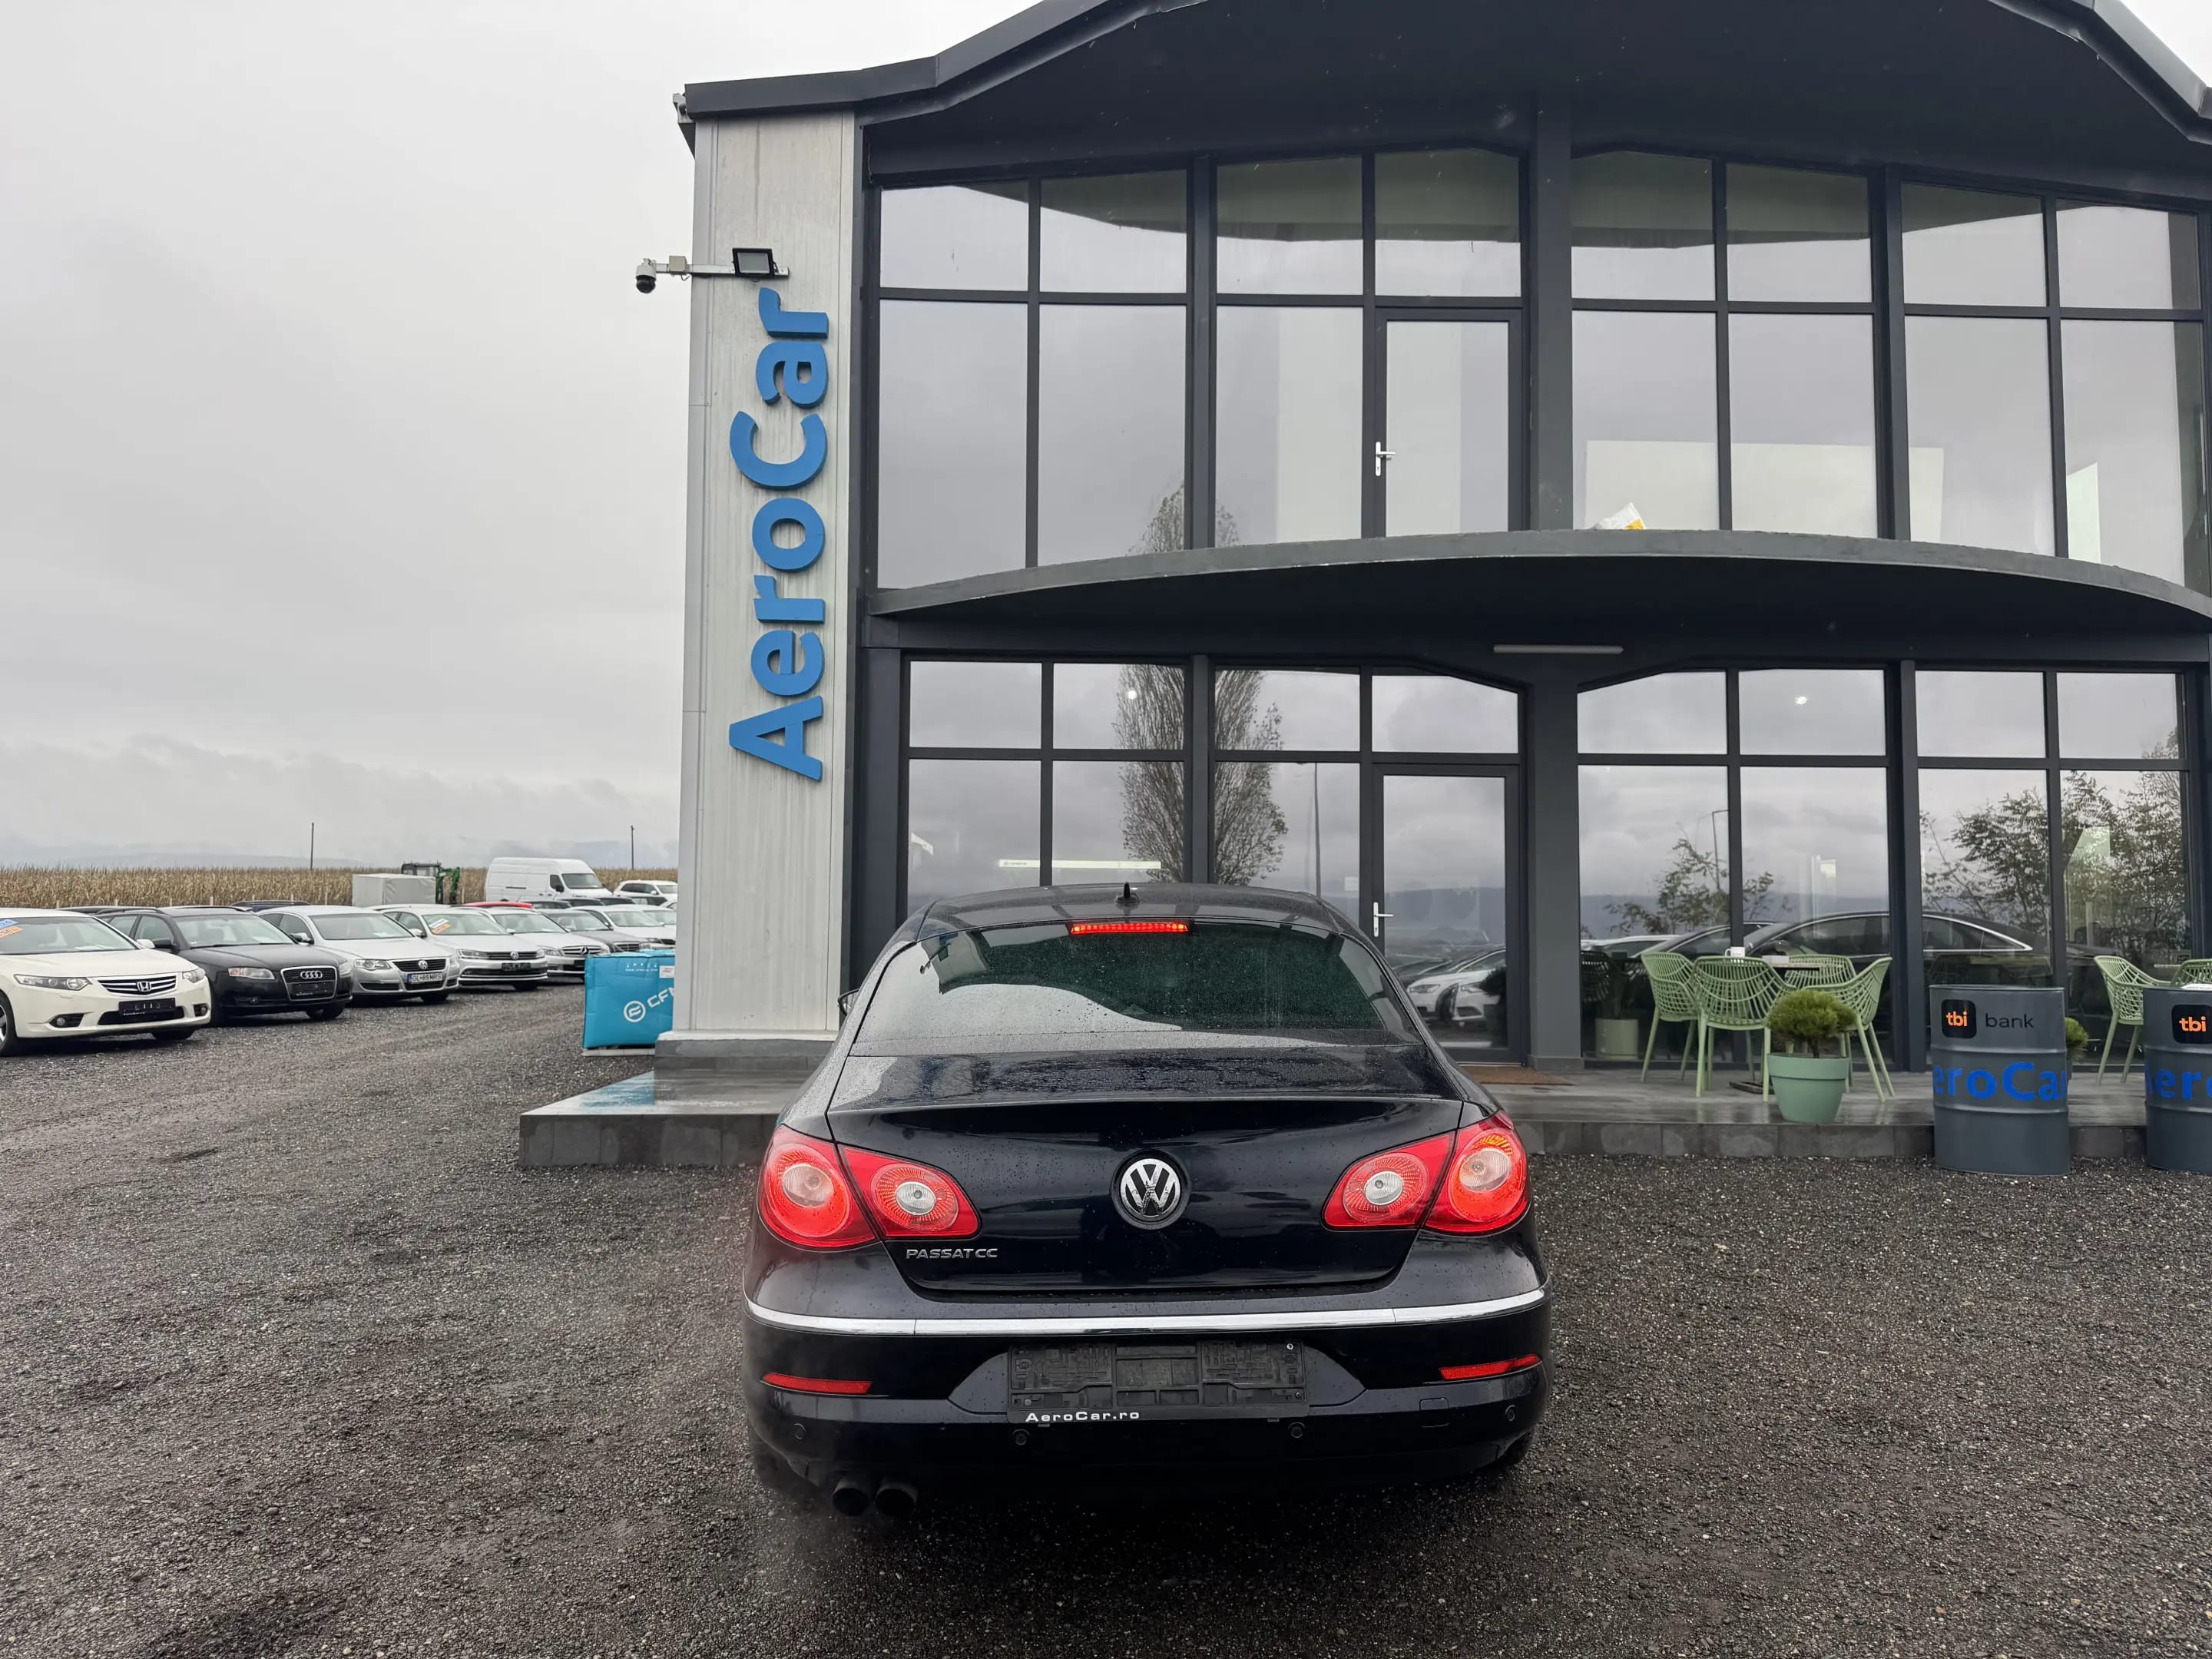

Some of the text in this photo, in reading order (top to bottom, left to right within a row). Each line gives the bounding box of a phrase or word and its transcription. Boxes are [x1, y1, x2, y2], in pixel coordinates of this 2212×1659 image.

[729, 286, 830, 782] AeroCar
[1946, 1011, 2034, 1028] tbi bank
[2178, 1015, 2207, 1032] tbi
[1025, 1411, 1140, 1422] AeroCar.ro
